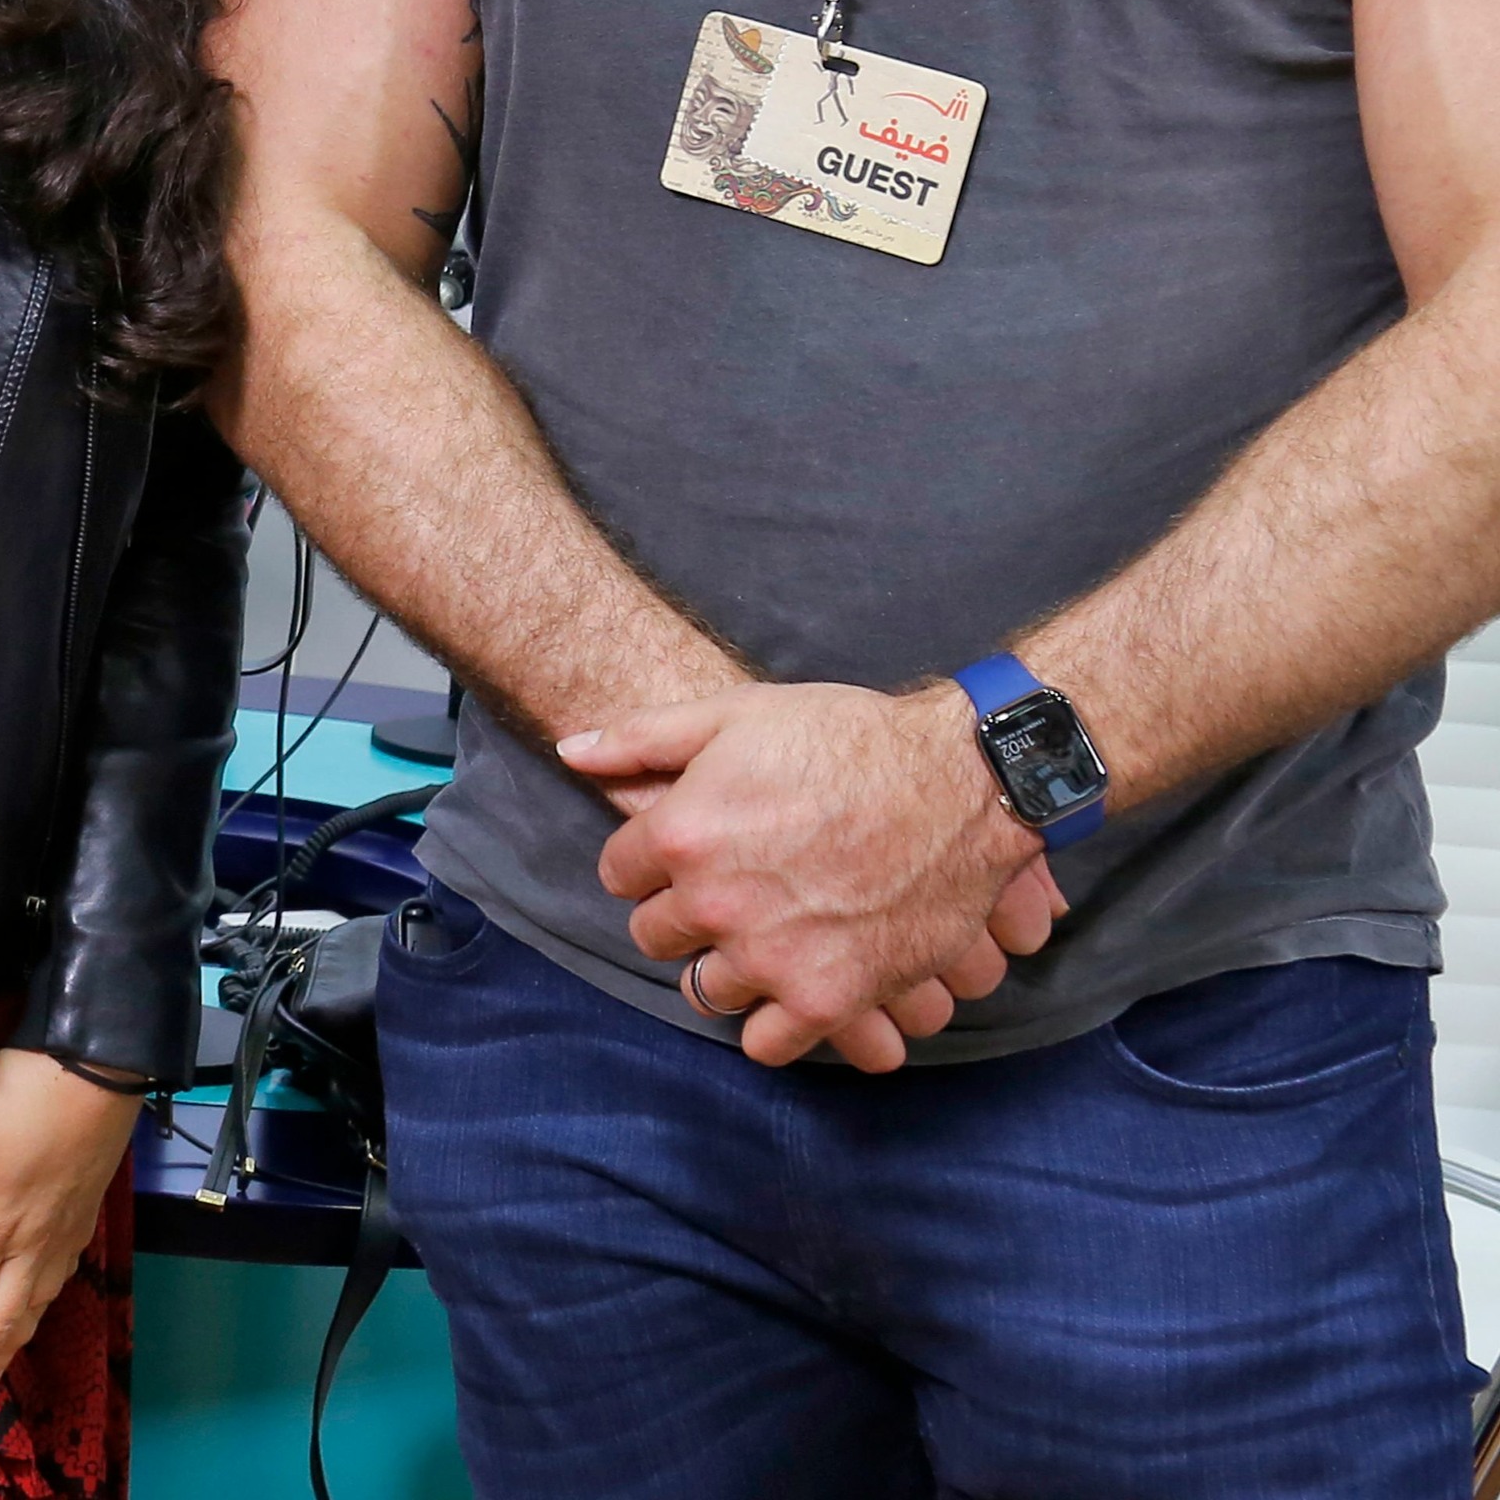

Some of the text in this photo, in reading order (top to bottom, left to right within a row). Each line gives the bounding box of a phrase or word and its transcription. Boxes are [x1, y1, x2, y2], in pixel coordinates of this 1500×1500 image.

[858, 118, 950, 165] ضيف
[817, 146, 940, 207] GUEST
[1000, 733, 1035, 759] 11:02
